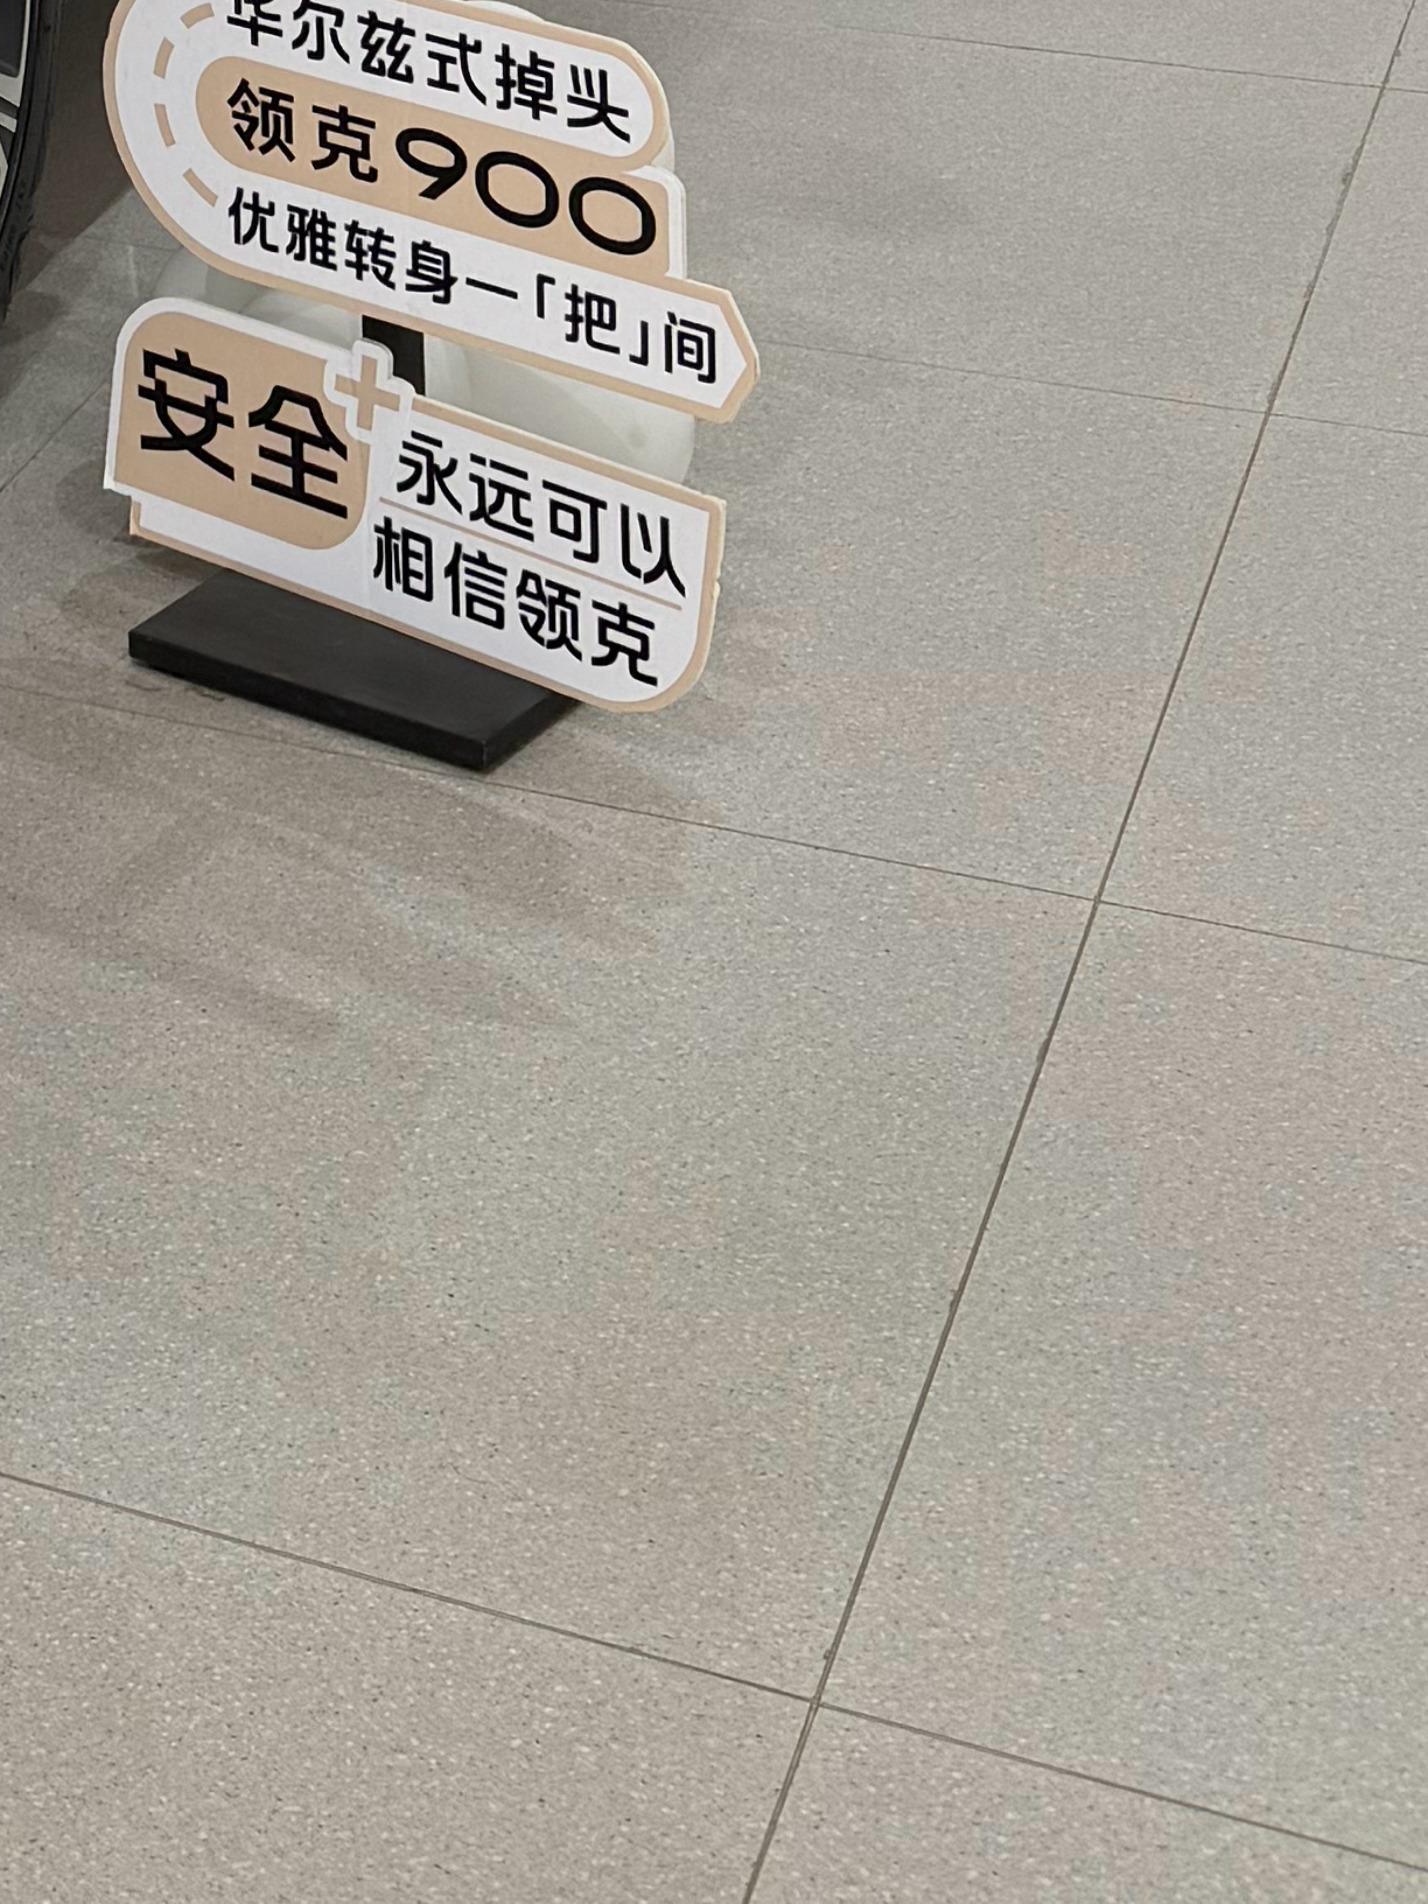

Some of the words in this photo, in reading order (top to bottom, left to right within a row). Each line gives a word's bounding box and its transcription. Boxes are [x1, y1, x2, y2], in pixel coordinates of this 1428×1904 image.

[137, 346, 349, 520] 安全
[394, 428, 688, 598] 永远可以
[371, 515, 659, 688] 相信领克
